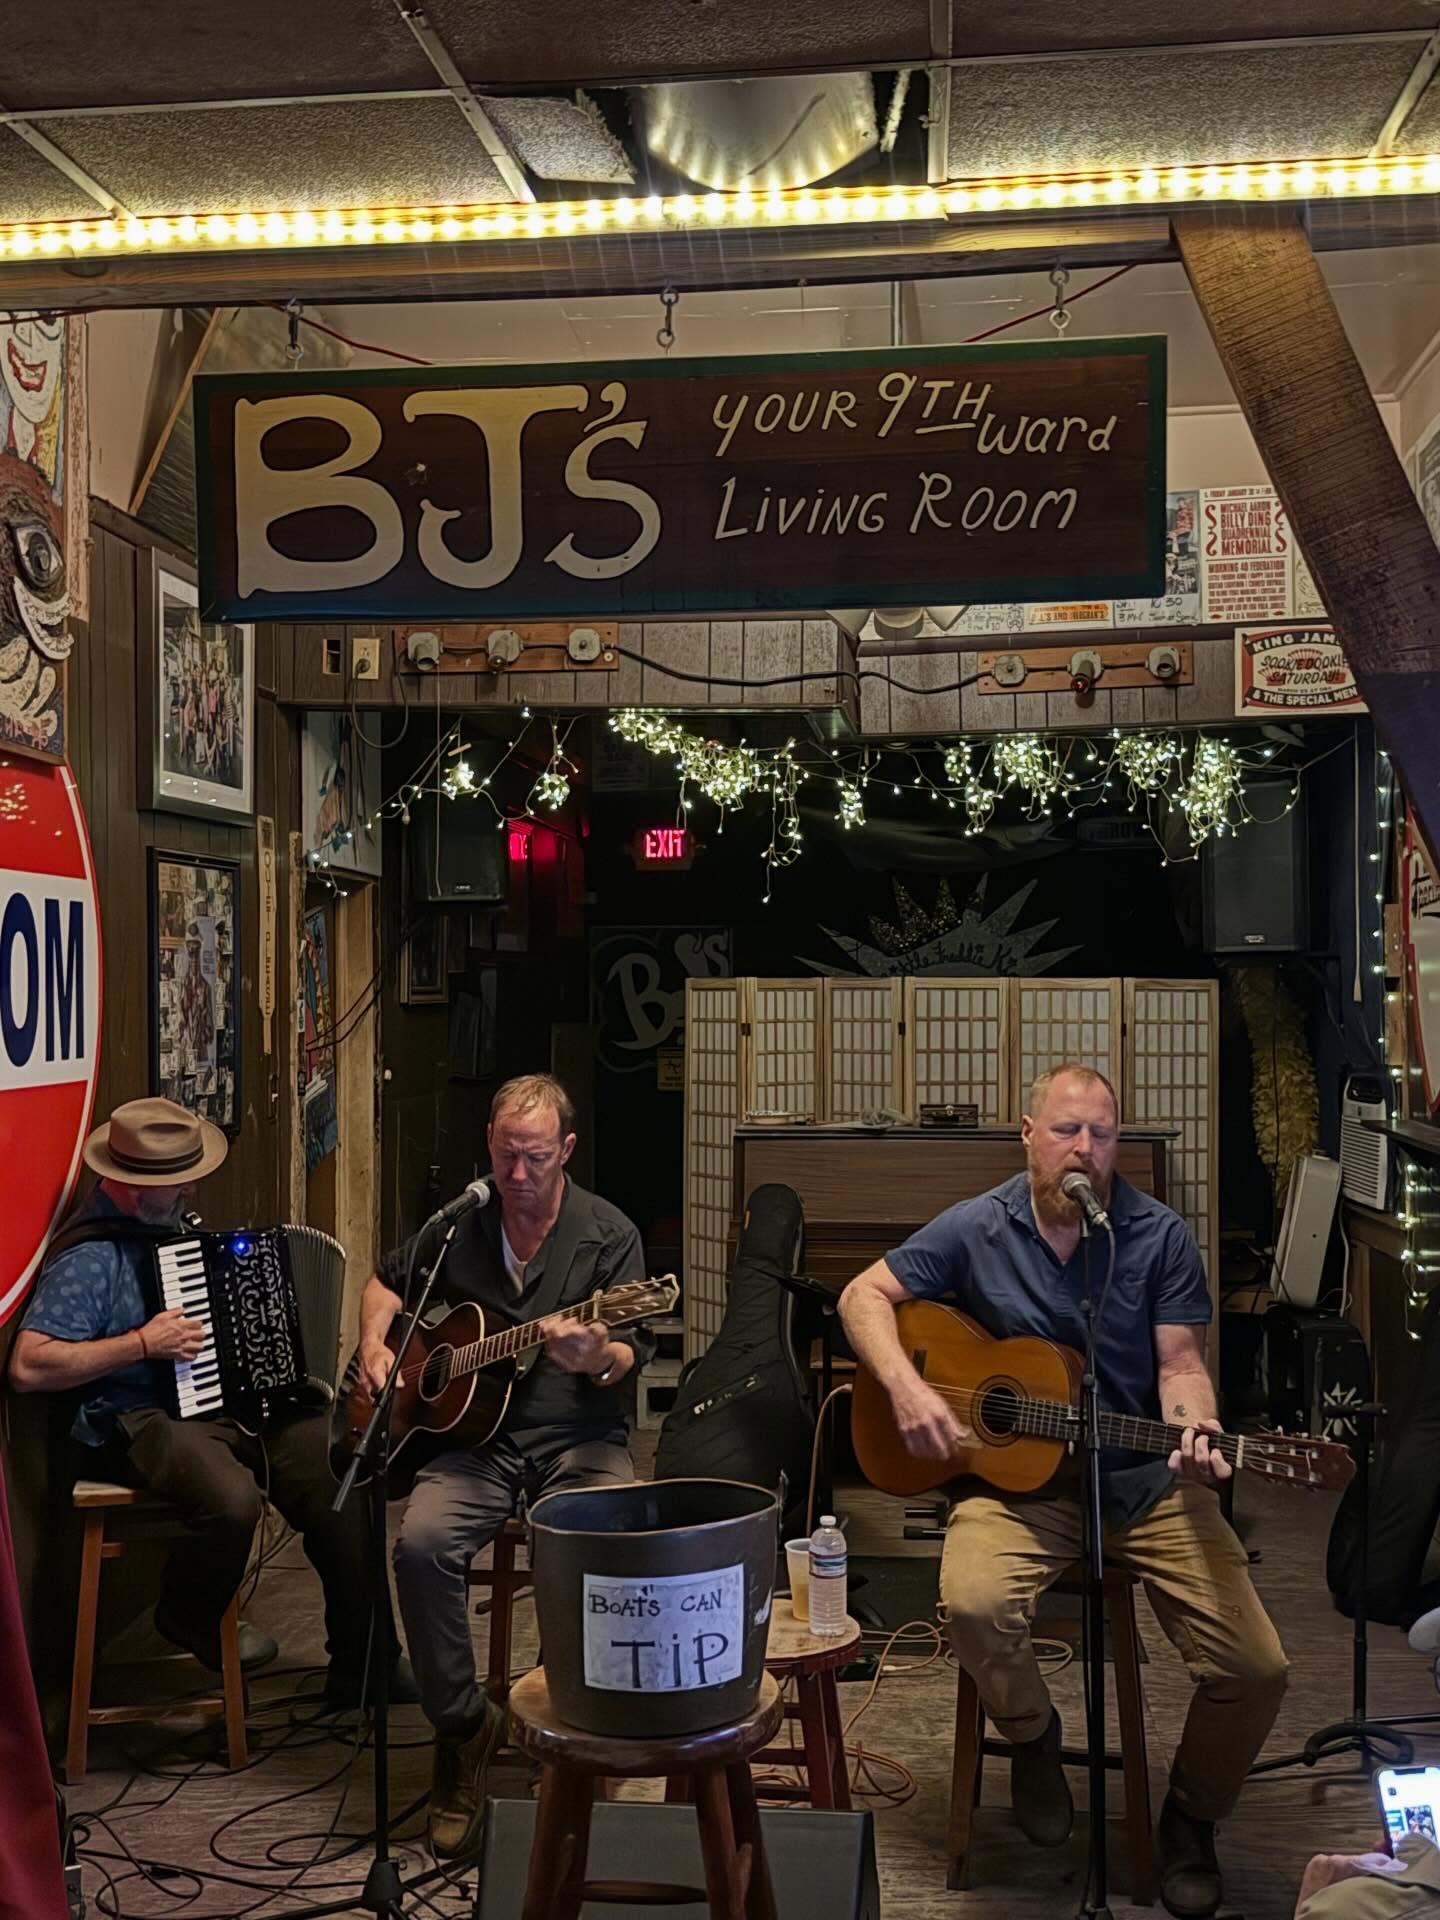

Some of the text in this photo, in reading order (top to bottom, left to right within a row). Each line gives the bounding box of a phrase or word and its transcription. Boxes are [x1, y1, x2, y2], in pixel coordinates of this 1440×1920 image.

[876, 372, 993, 437] 9TH
[1220, 503, 1247, 513] MICHAEL
[1220, 511, 1271, 528] BILLY DING
[1221, 526, 1272, 540] QUADRENNIAL
[1221, 538, 1272, 555] MEMORIAL
[1252, 633, 1294, 652] KING
[1252, 689, 1260, 699] &
[1263, 691, 1284, 704] THE
[1286, 694, 1332, 705] SPECIAL
[1333, 686, 1359, 701] MEN
[646, 829, 685, 858] EXIT
[680, 1588, 723, 1611] CAN
